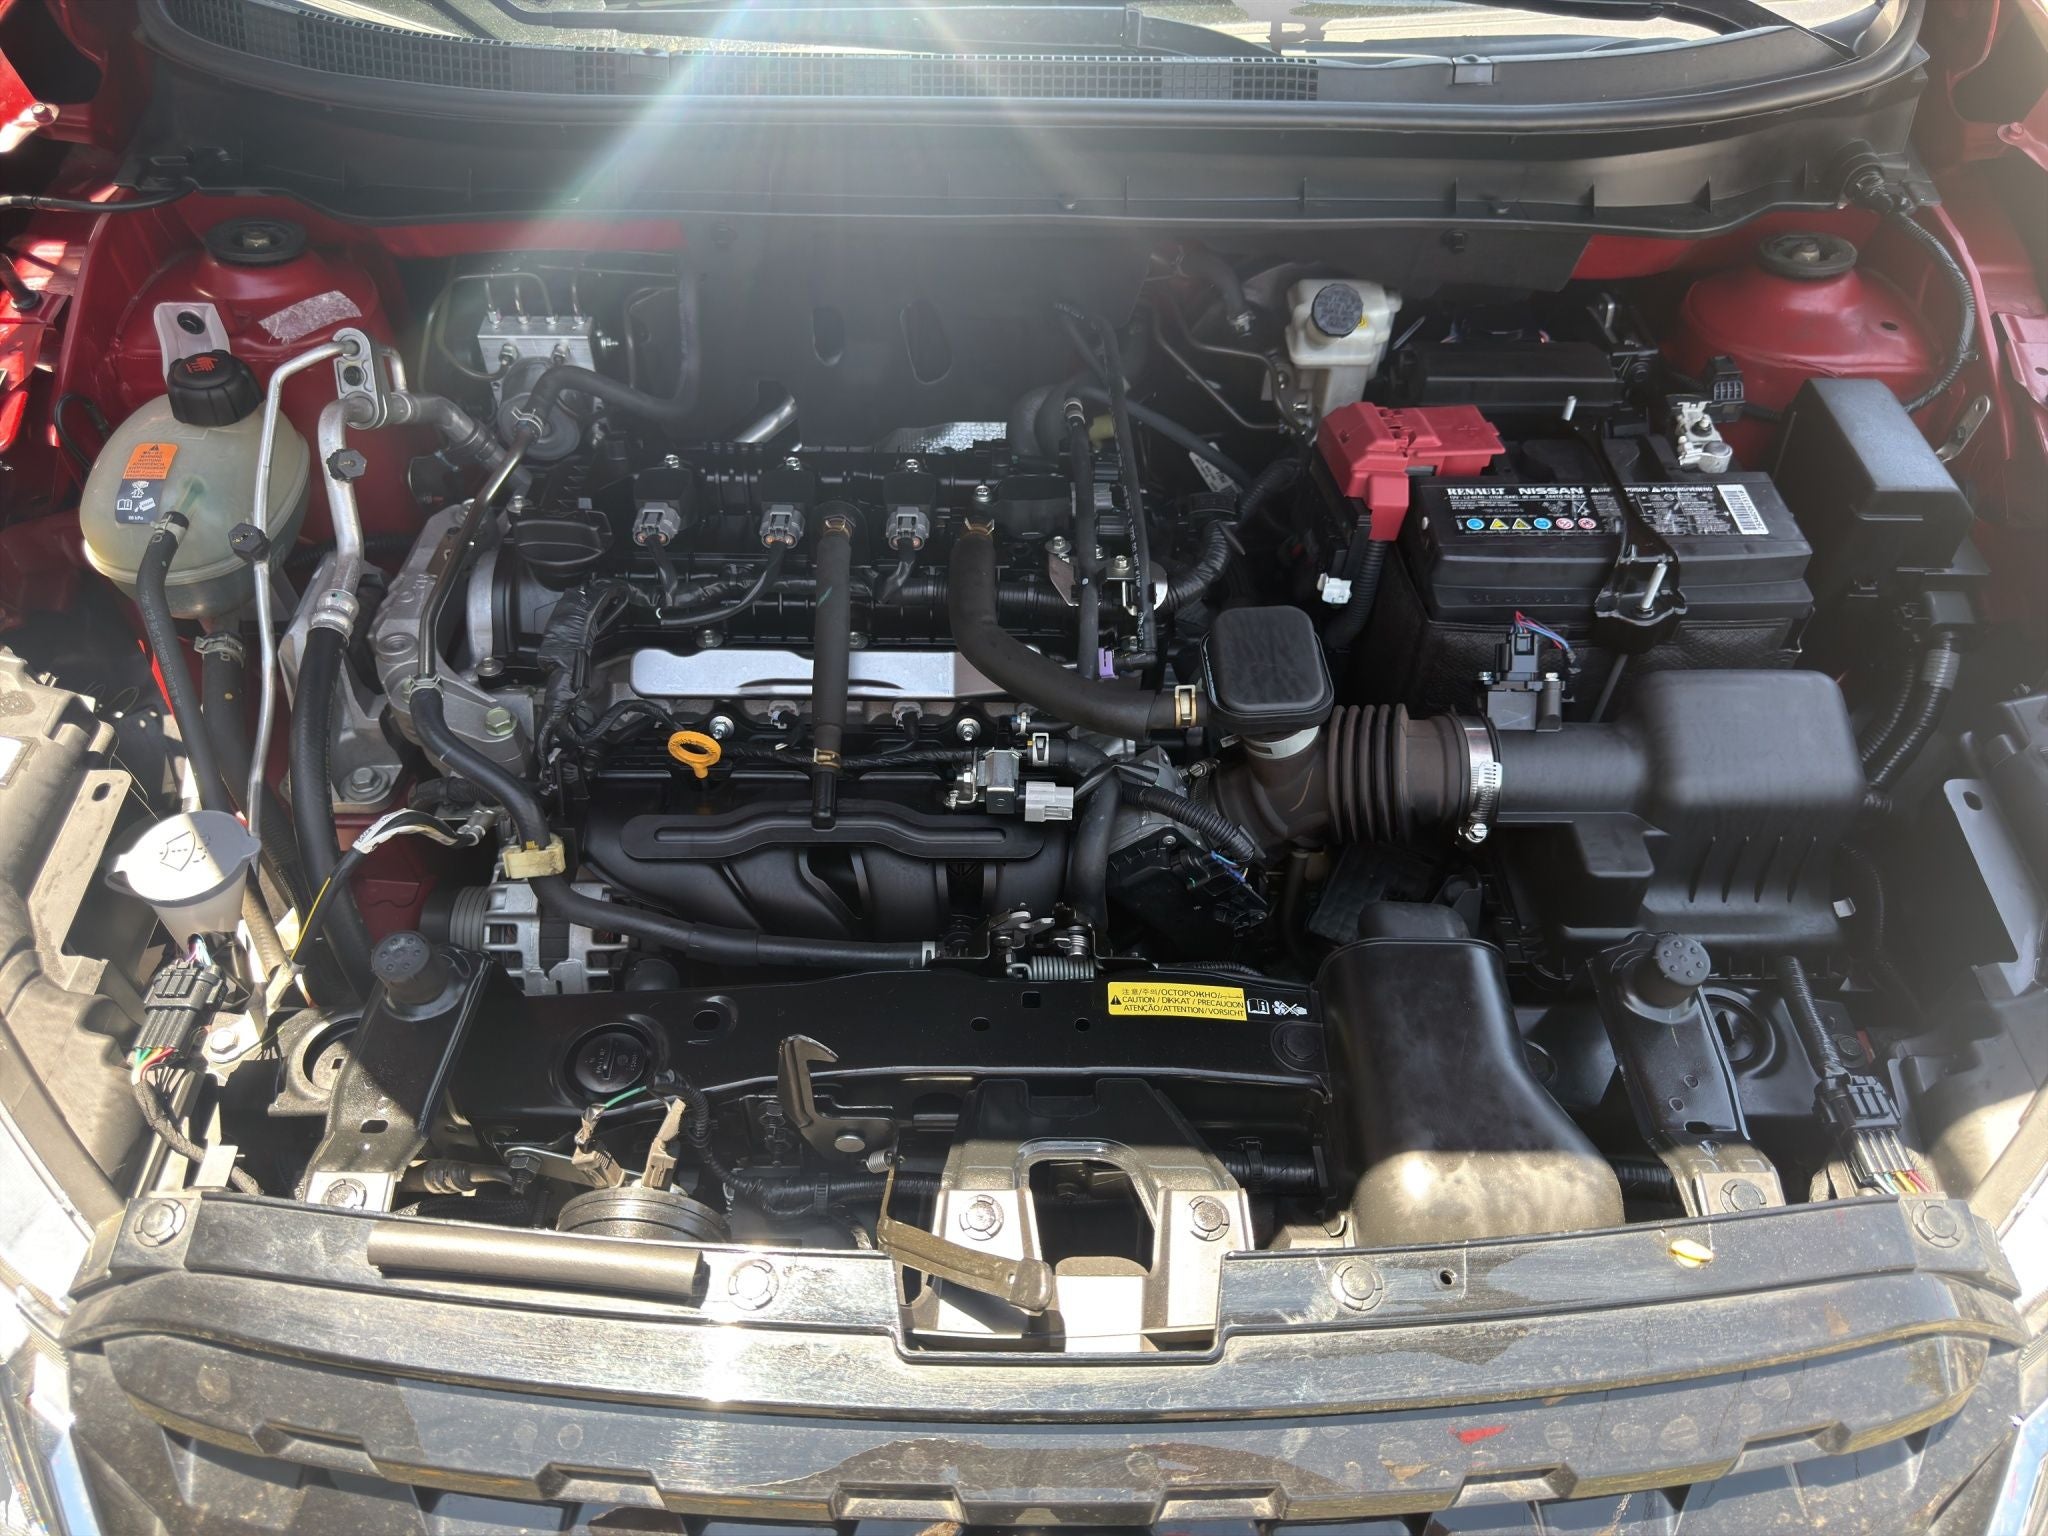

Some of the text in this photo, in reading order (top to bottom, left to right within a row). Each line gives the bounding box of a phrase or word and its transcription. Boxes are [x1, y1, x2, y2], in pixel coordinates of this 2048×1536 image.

[1446, 487, 1584, 495] RENAULT NISSAN
[1161, 996, 1190, 1005] DIKKAT
